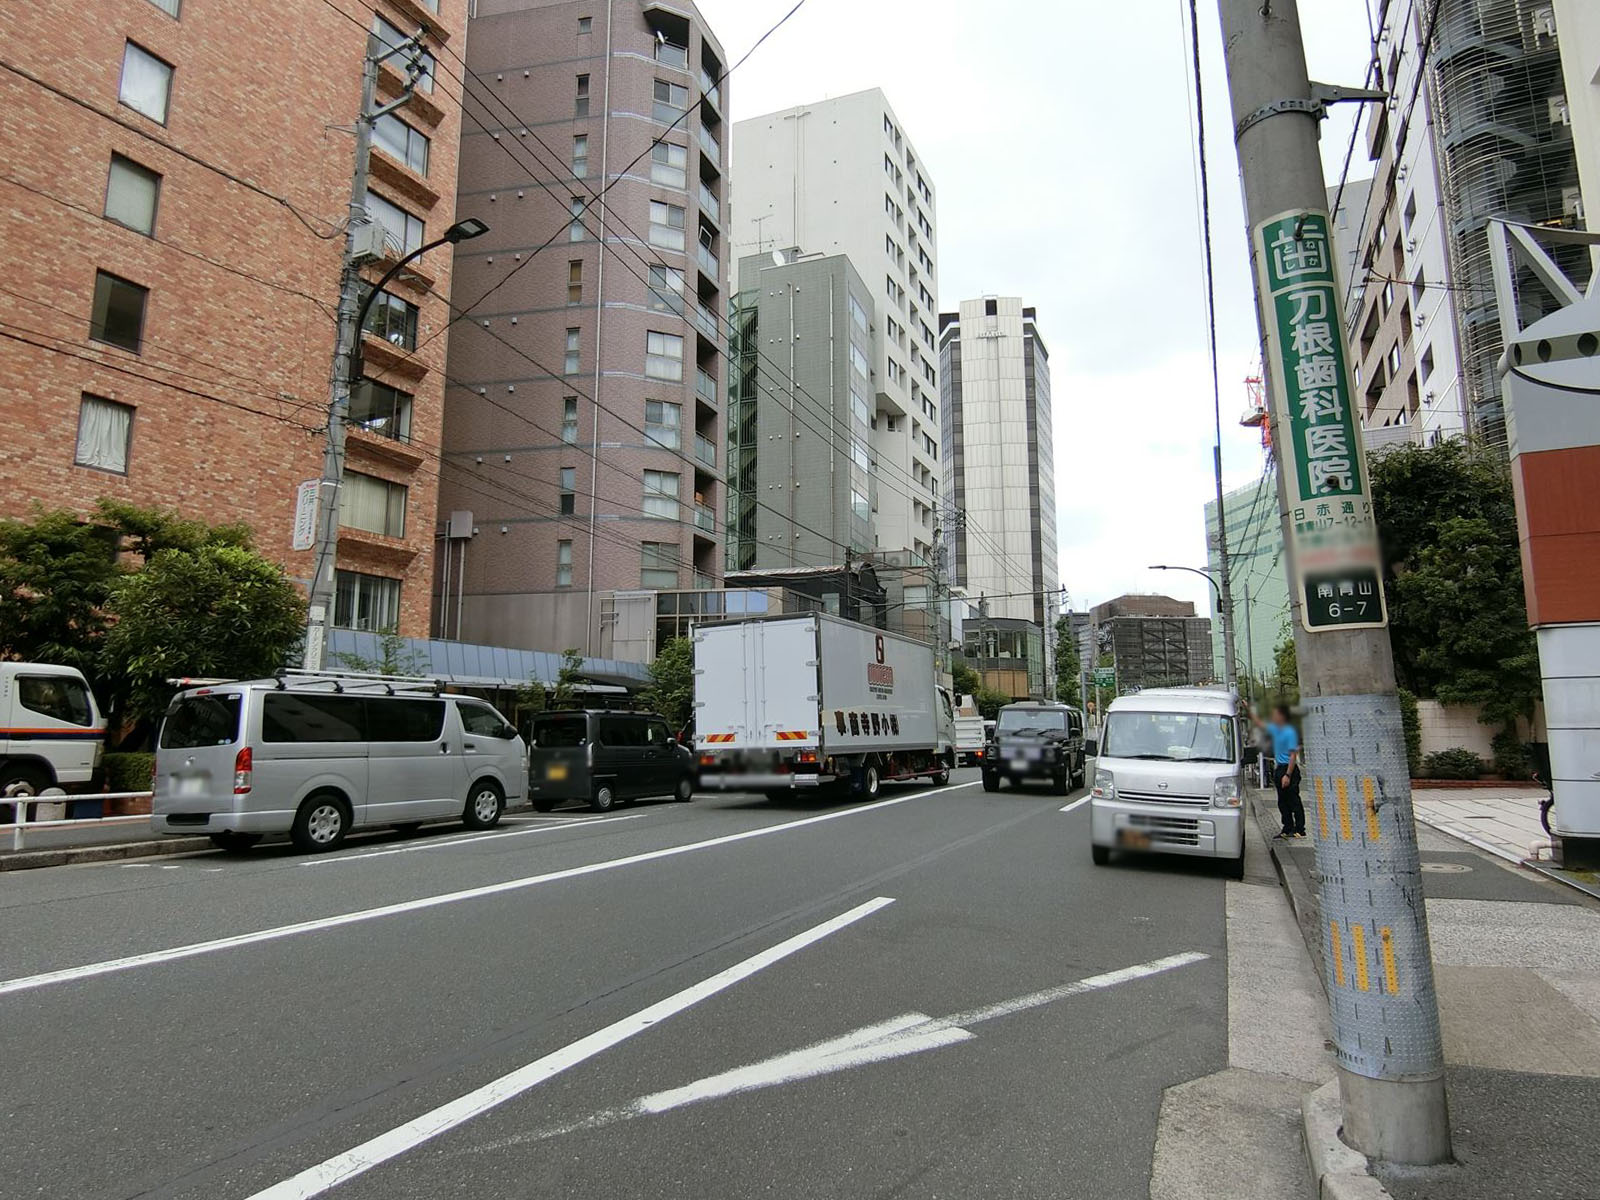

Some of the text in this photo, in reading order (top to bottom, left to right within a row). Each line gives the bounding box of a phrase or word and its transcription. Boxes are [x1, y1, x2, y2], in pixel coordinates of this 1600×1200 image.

[1288, 289, 1353, 496] 刀根歯科医院
[1294, 501, 1371, 521] 日赤通り
[1328, 601, 1367, 618] 6-7
